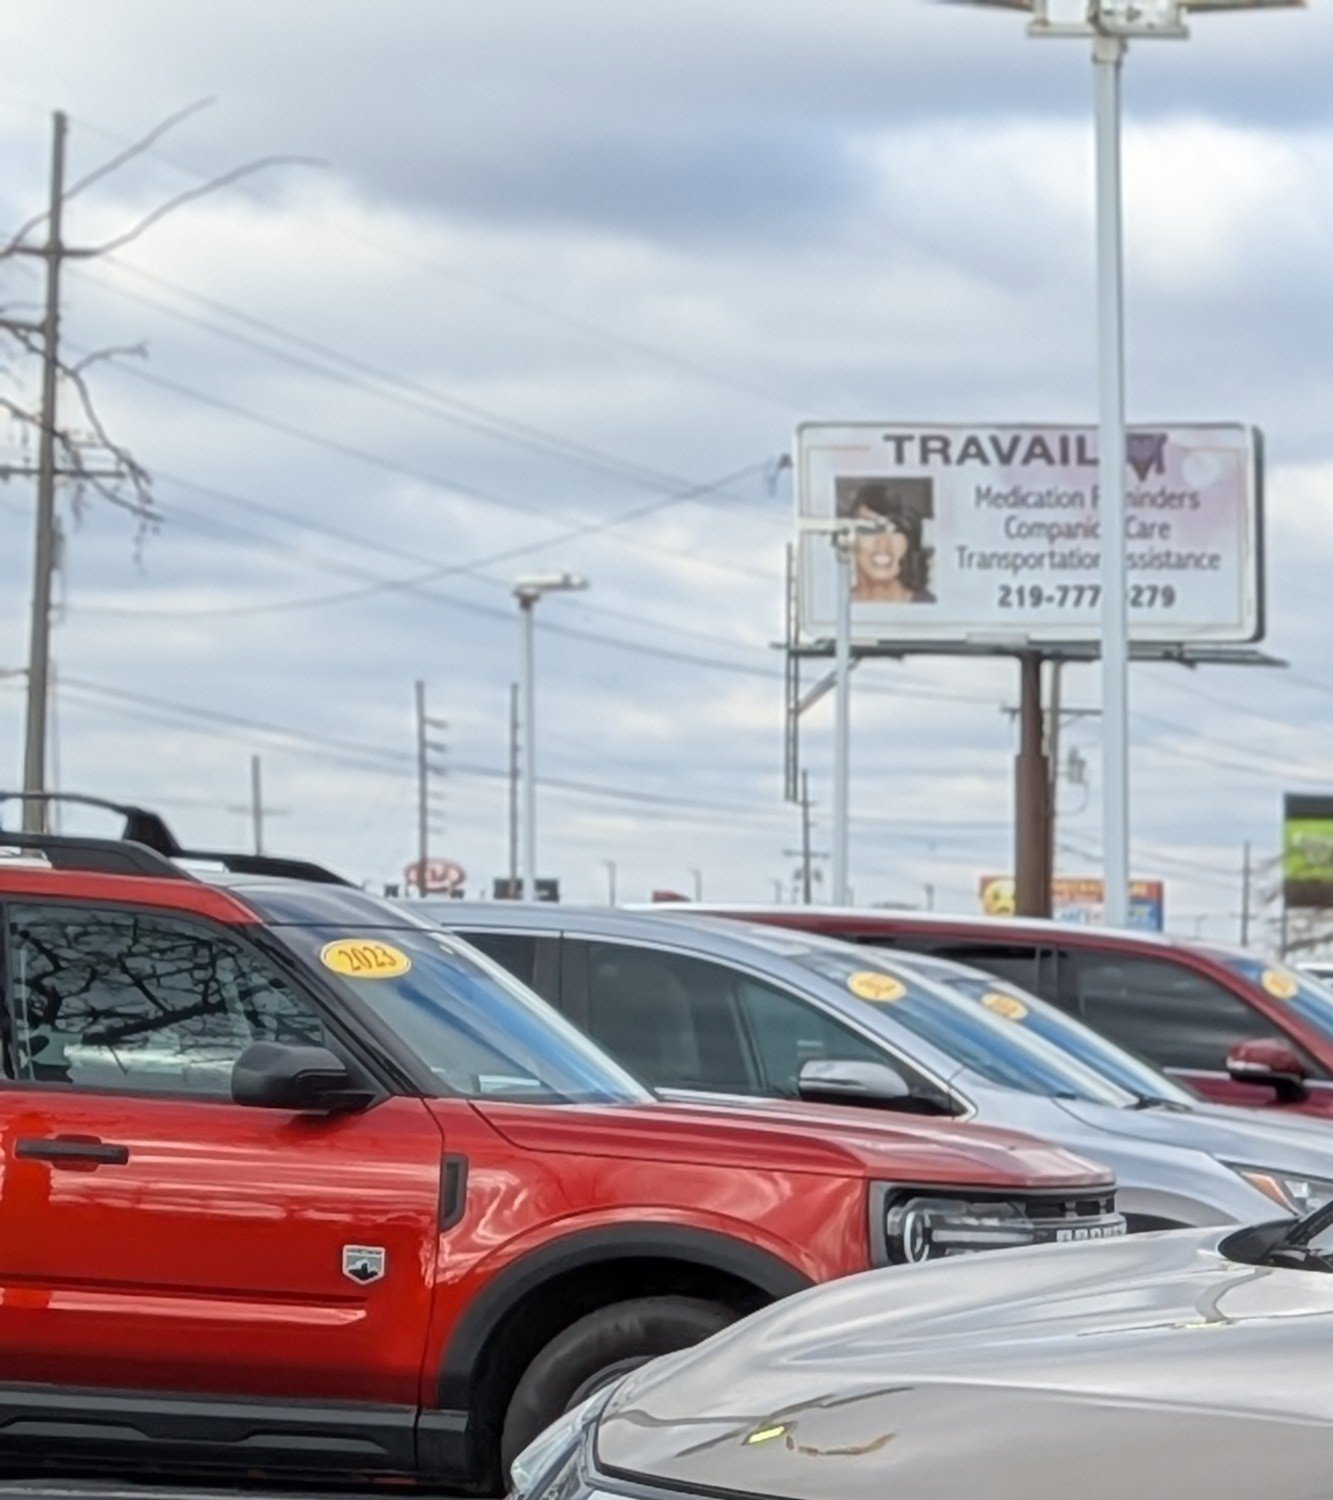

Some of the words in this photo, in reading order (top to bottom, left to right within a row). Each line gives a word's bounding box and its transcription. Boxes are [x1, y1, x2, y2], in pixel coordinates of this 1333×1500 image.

[974, 483, 1085, 510] Medication
[1091, 483, 1201, 511] inders
[1004, 514, 1101, 544] Compani
[1126, 514, 1172, 540] Care
[1126, 547, 1222, 571] ssistance
[997, 583, 1177, 608] 219-777279
[337, 945, 398, 972] 2023
